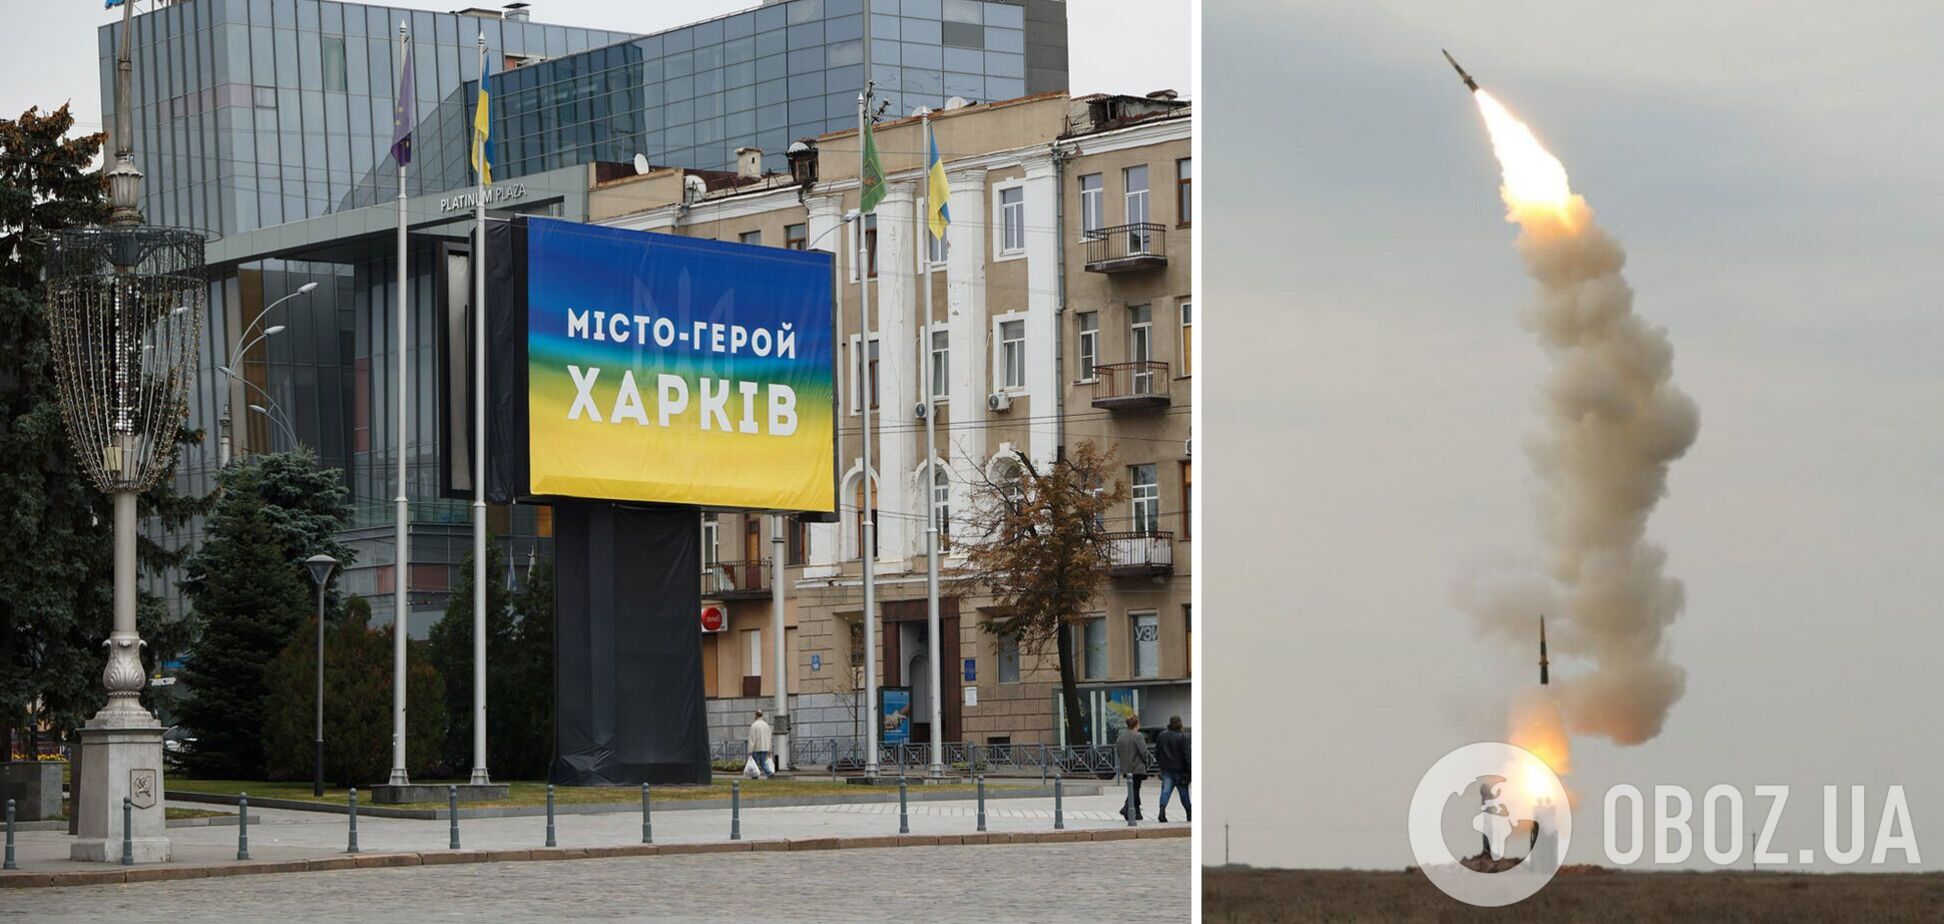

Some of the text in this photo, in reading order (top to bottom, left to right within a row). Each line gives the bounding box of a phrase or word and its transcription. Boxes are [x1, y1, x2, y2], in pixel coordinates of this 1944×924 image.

[496, 184, 526, 200] PLAZA
[566, 307, 796, 360] МІСТО-ГЕРОЙ
[566, 365, 798, 437] ХАРКІВ
